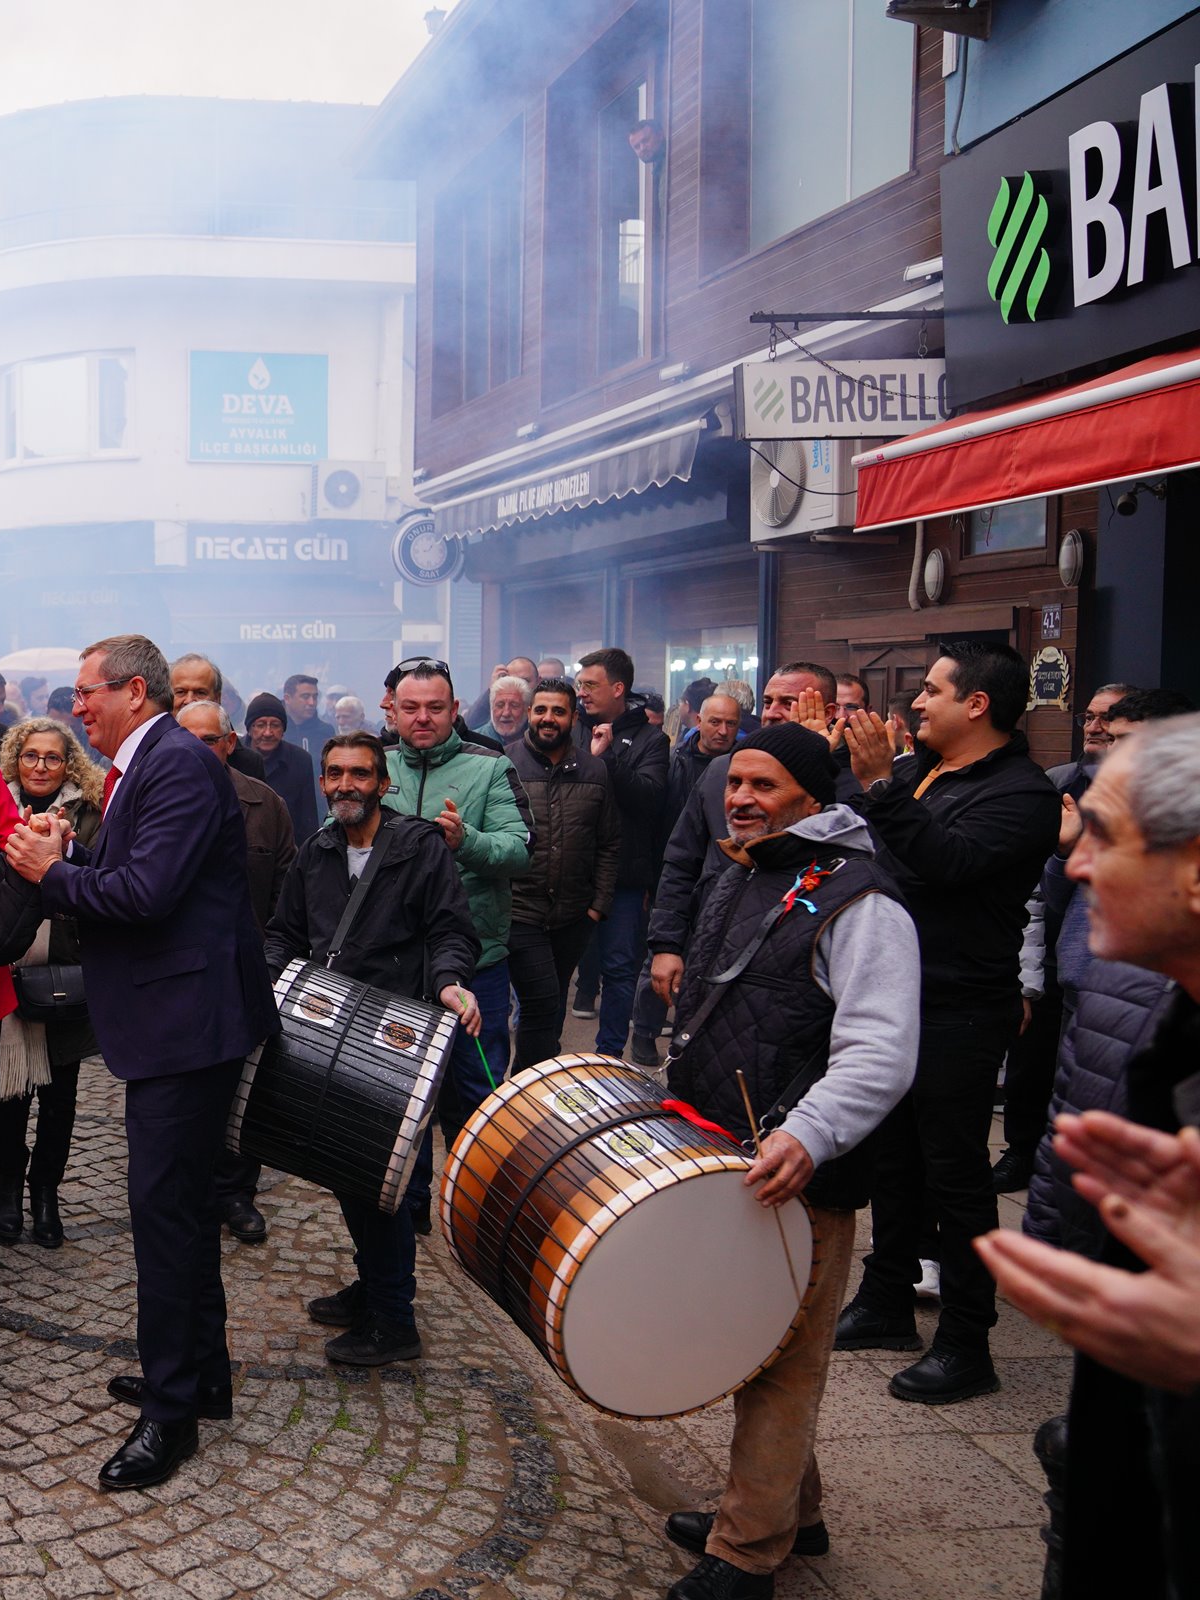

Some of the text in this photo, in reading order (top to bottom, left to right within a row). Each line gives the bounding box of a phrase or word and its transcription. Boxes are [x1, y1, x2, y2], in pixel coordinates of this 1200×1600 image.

[1068, 62, 1200, 308] BA
[222, 394, 293, 415] DEVA
[229, 428, 287, 439] AYVALIK
[200, 440, 316, 456] İLÇE BAŞKANLIĞI
[407, 524, 434, 541] ONUR
[418, 569, 440, 578] SAAT
